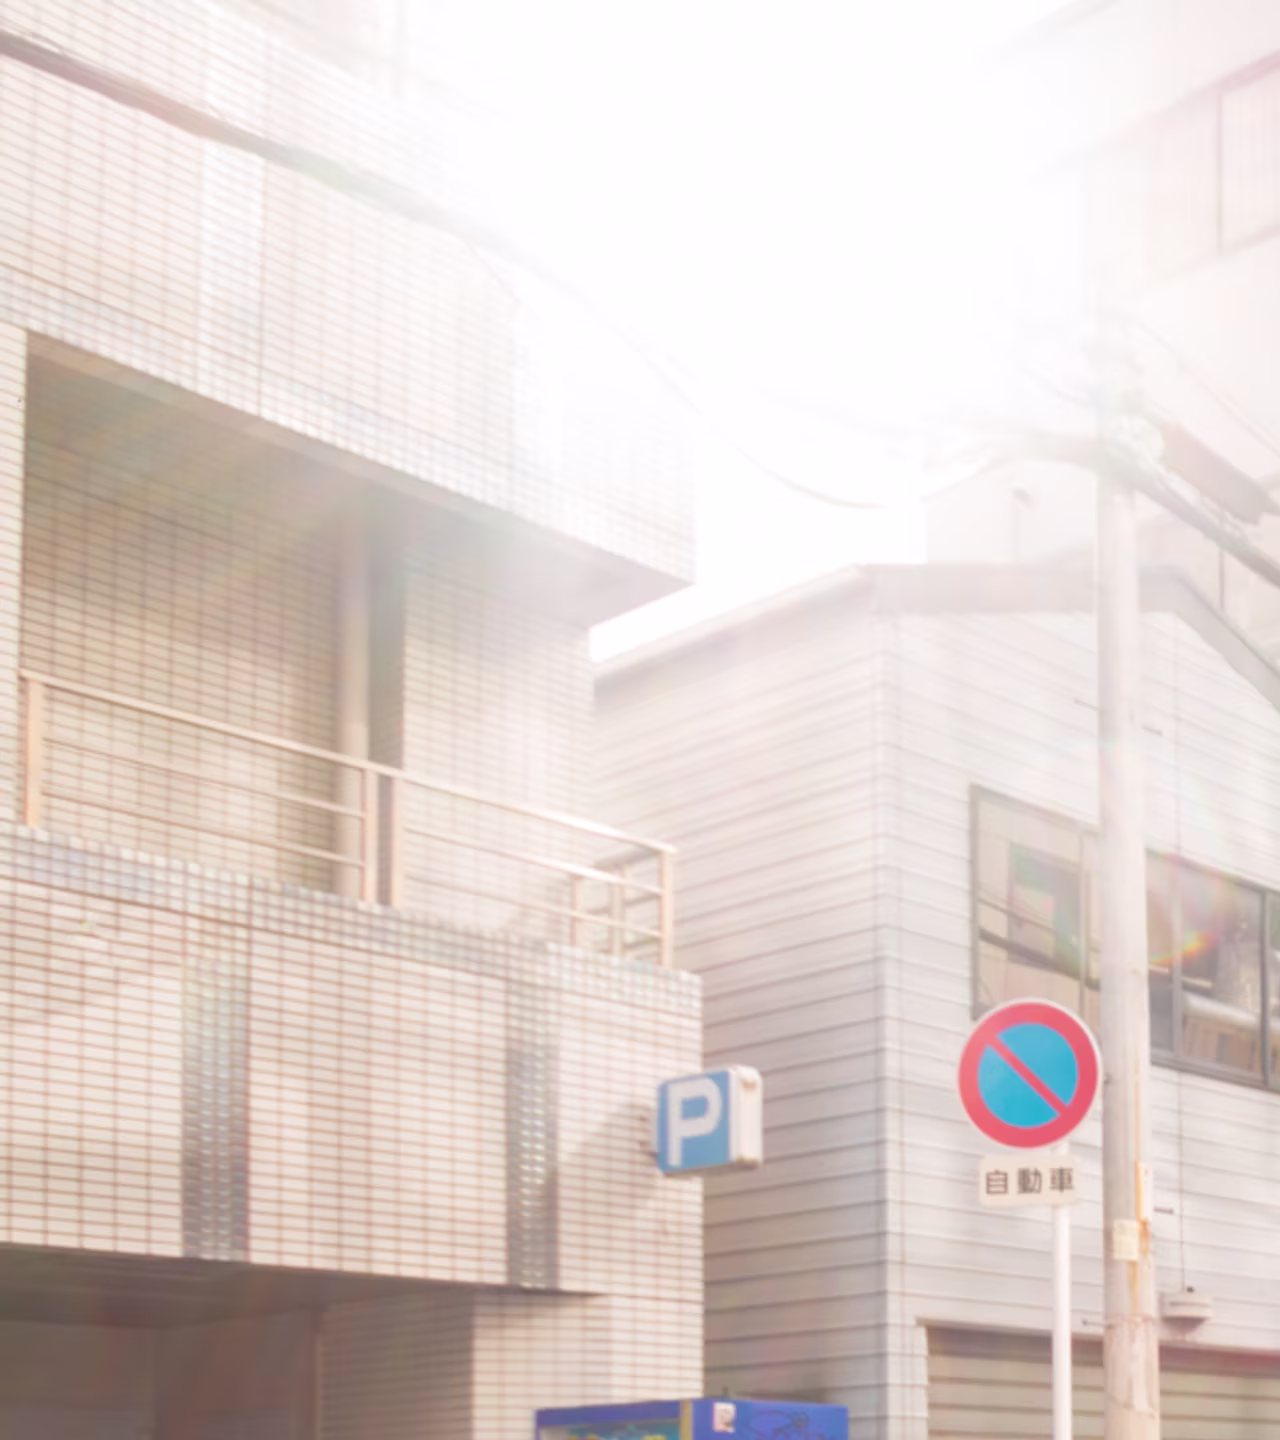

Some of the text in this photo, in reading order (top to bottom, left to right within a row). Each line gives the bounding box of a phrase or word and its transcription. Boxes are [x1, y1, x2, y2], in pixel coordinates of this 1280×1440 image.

[667, 1079, 722, 1167] P
[985, 1167, 1075, 1195] 自動車
